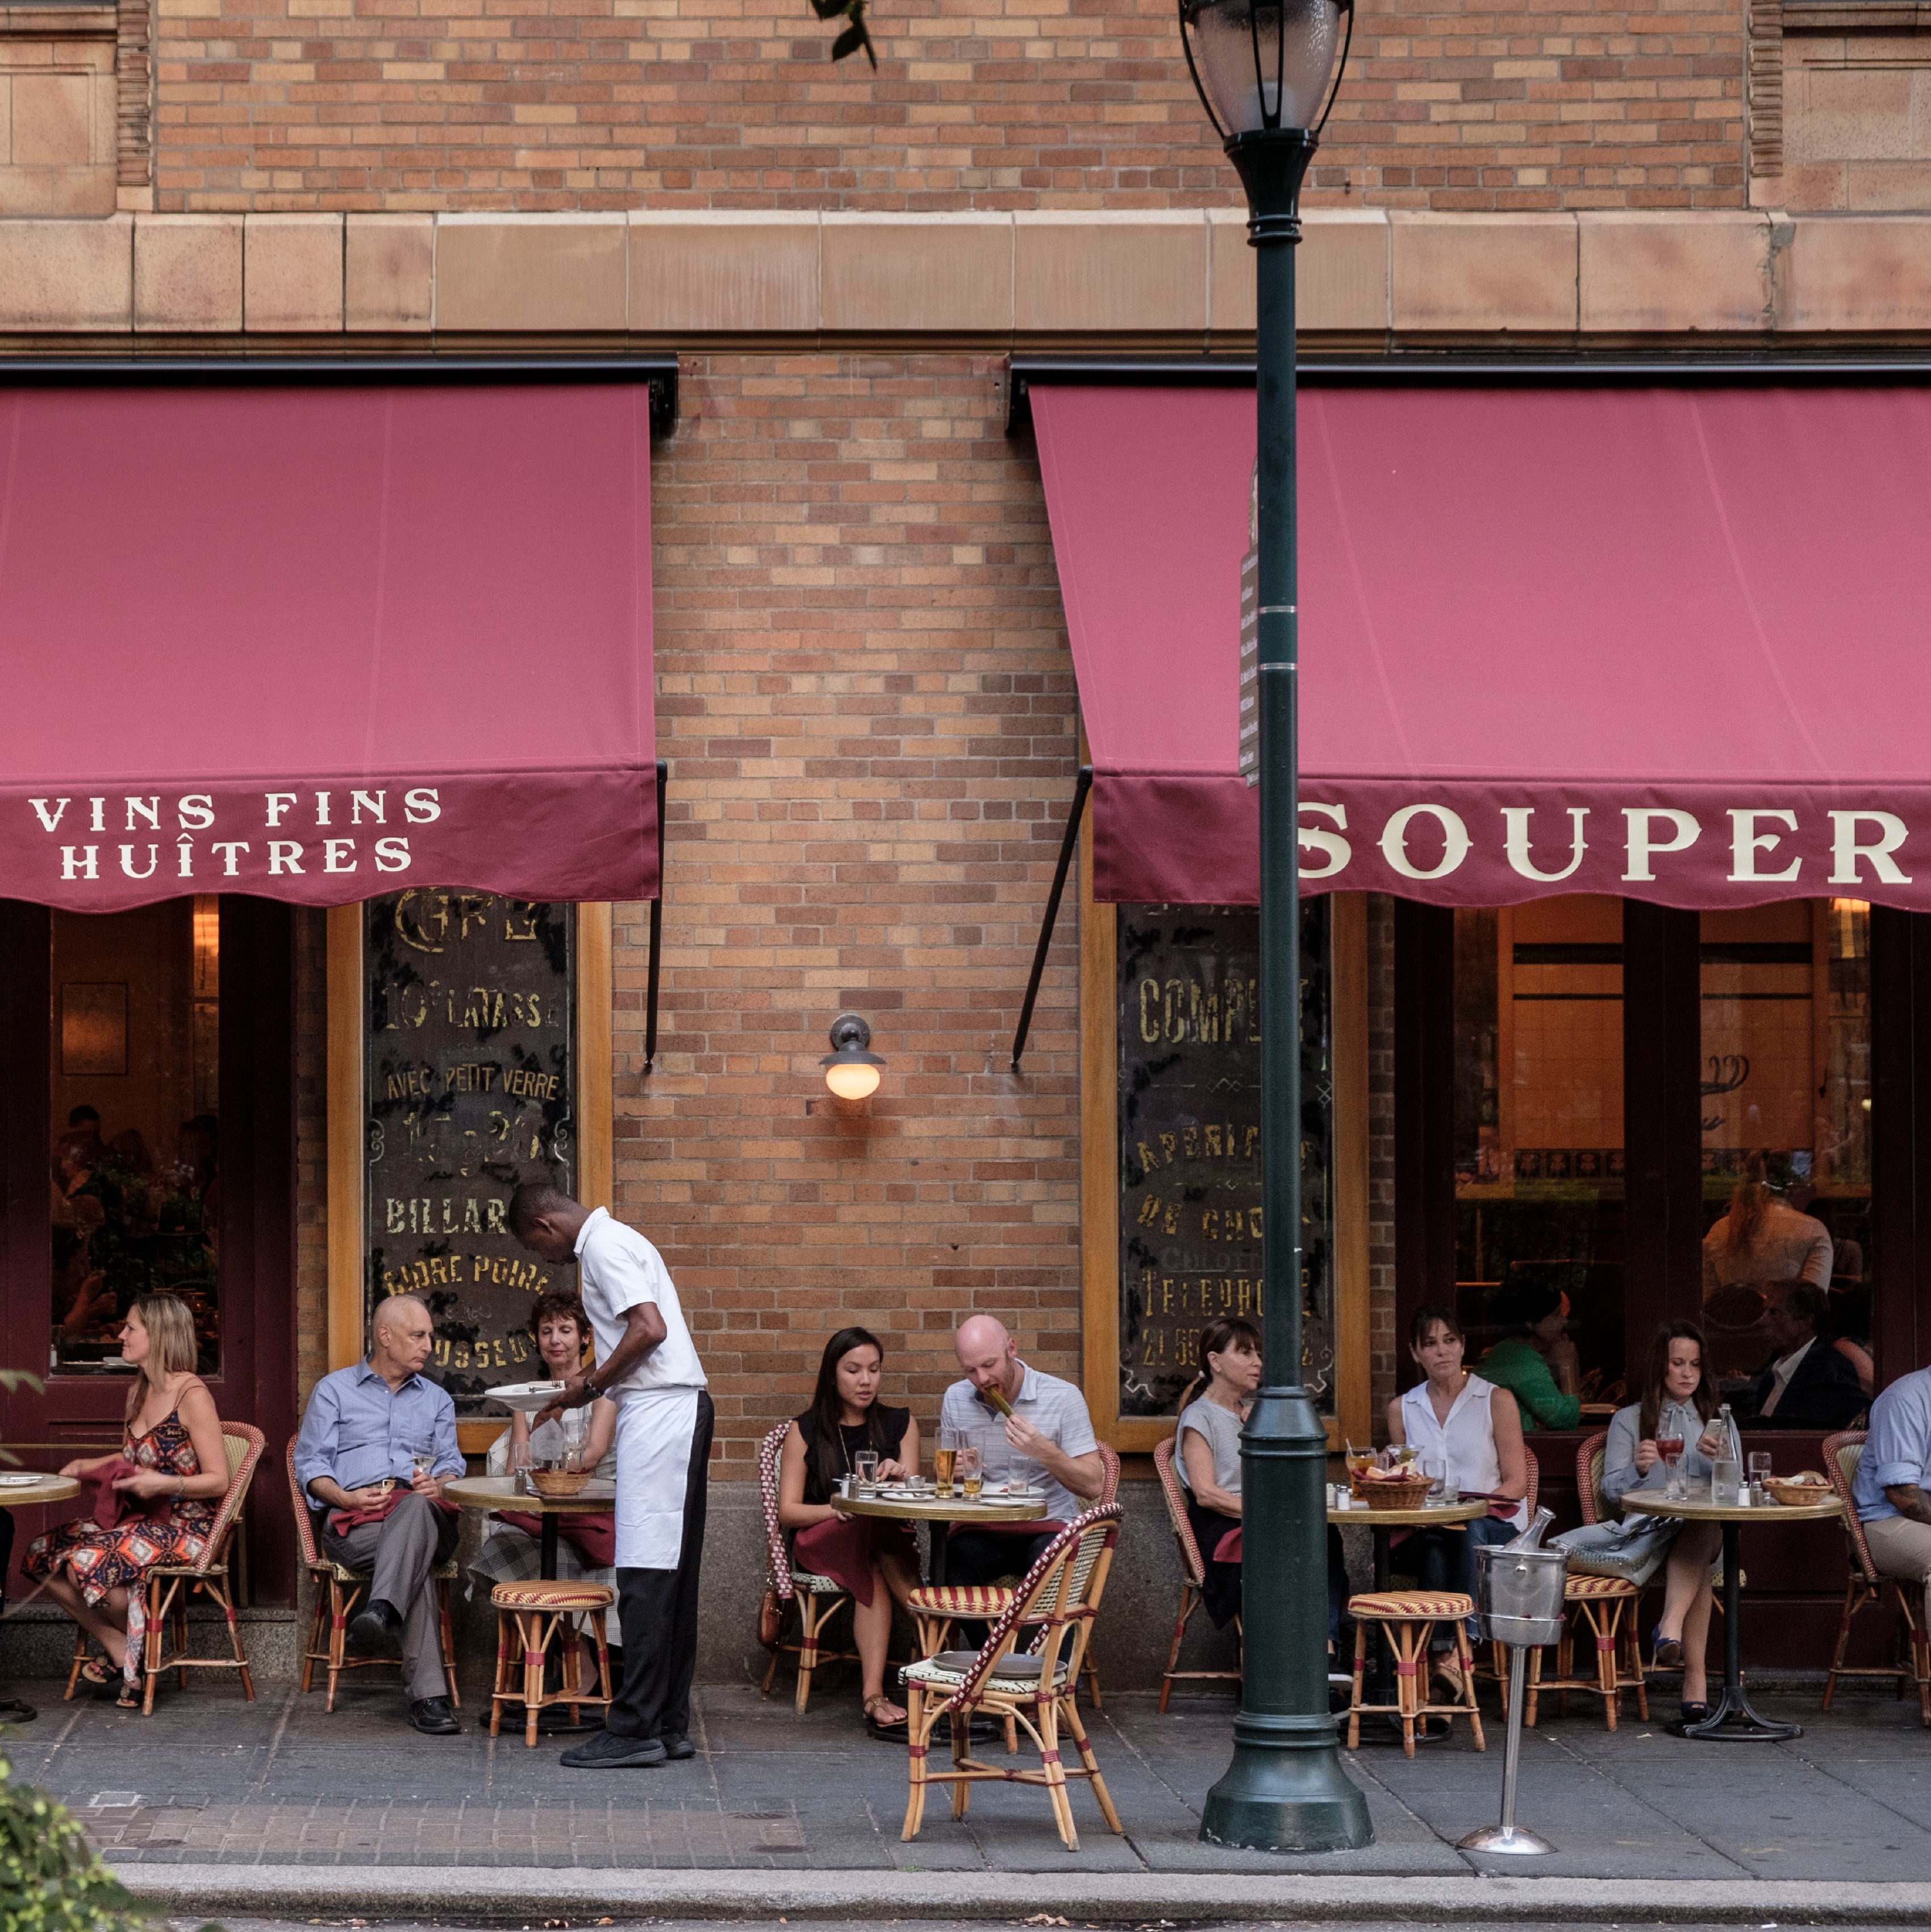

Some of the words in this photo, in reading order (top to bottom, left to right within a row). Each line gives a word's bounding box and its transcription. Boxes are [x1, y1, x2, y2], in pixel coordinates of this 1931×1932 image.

[28, 794, 215, 832] VINS
[265, 788, 441, 827] FINS
[60, 832, 411, 880] HUÎTRES
[1298, 802, 1913, 885] SOUPER
[387, 1069, 431, 1100] AVEC
[445, 1063, 495, 1092] PETIT
[503, 1069, 560, 1101] VERRE
[386, 1197, 507, 1235] BILLAR
[383, 1255, 462, 1297] CIDRE
[474, 1255, 554, 1296] POIRE
[435, 1332, 539, 1368] USSEU
